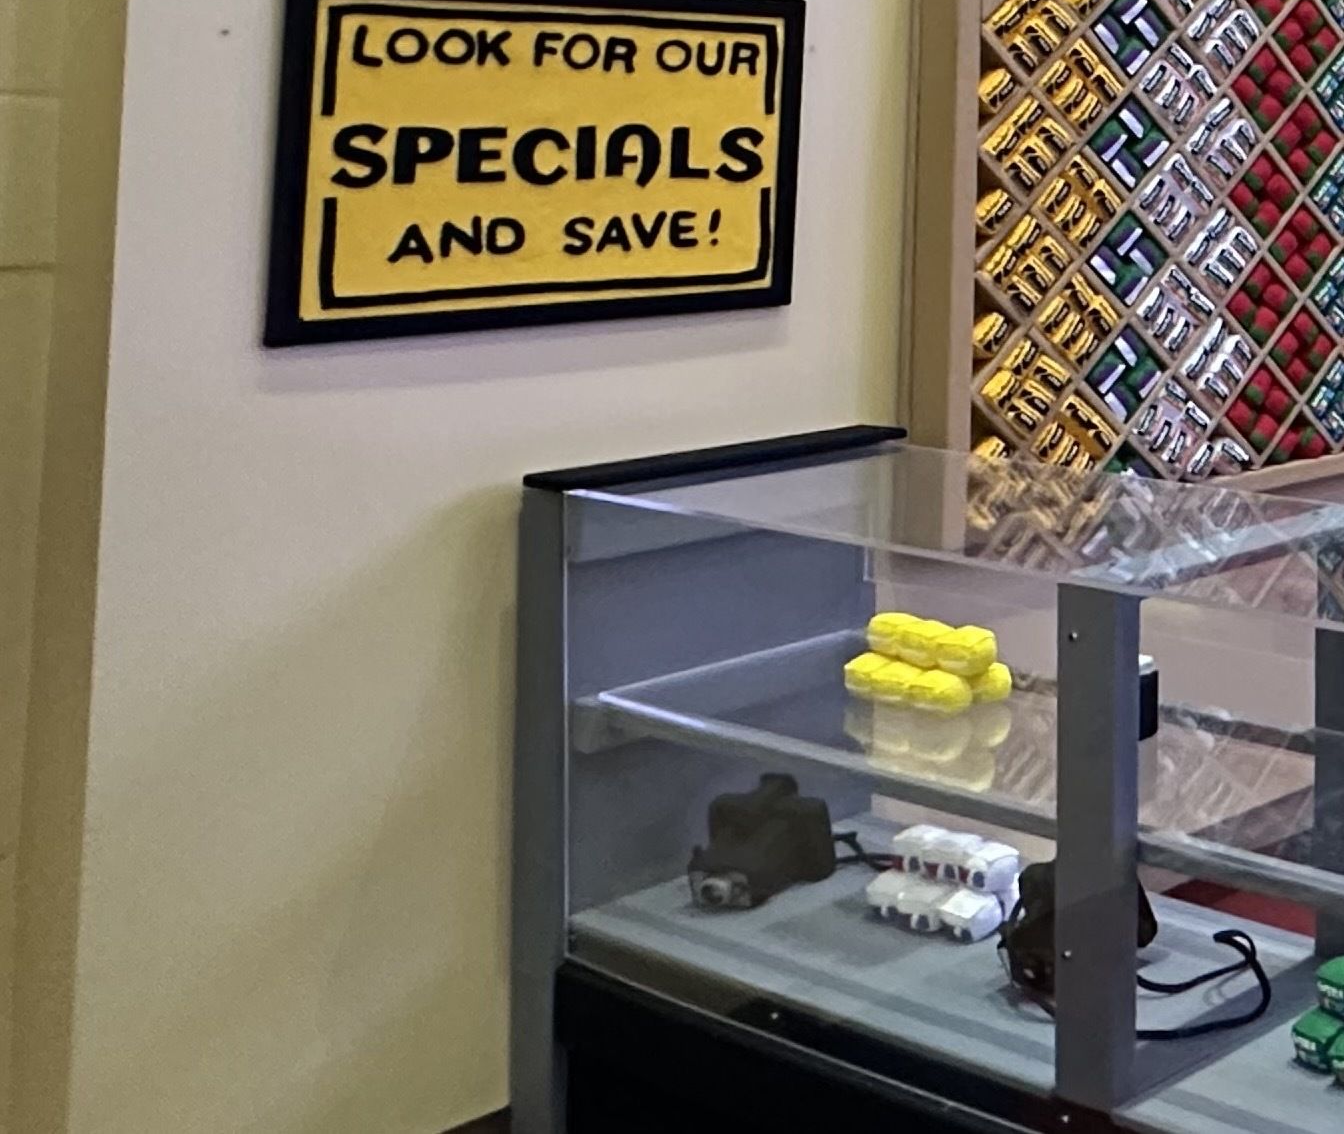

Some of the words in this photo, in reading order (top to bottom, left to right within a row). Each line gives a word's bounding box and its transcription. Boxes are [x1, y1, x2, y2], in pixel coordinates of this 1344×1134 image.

[352, 24, 513, 68] LOOK
[532, 30, 638, 75] FOR
[655, 38, 761, 77] OUR
[330, 122, 766, 190] SPECIALS
[386, 214, 527, 265] AND
[562, 208, 723, 256] SAVE!
